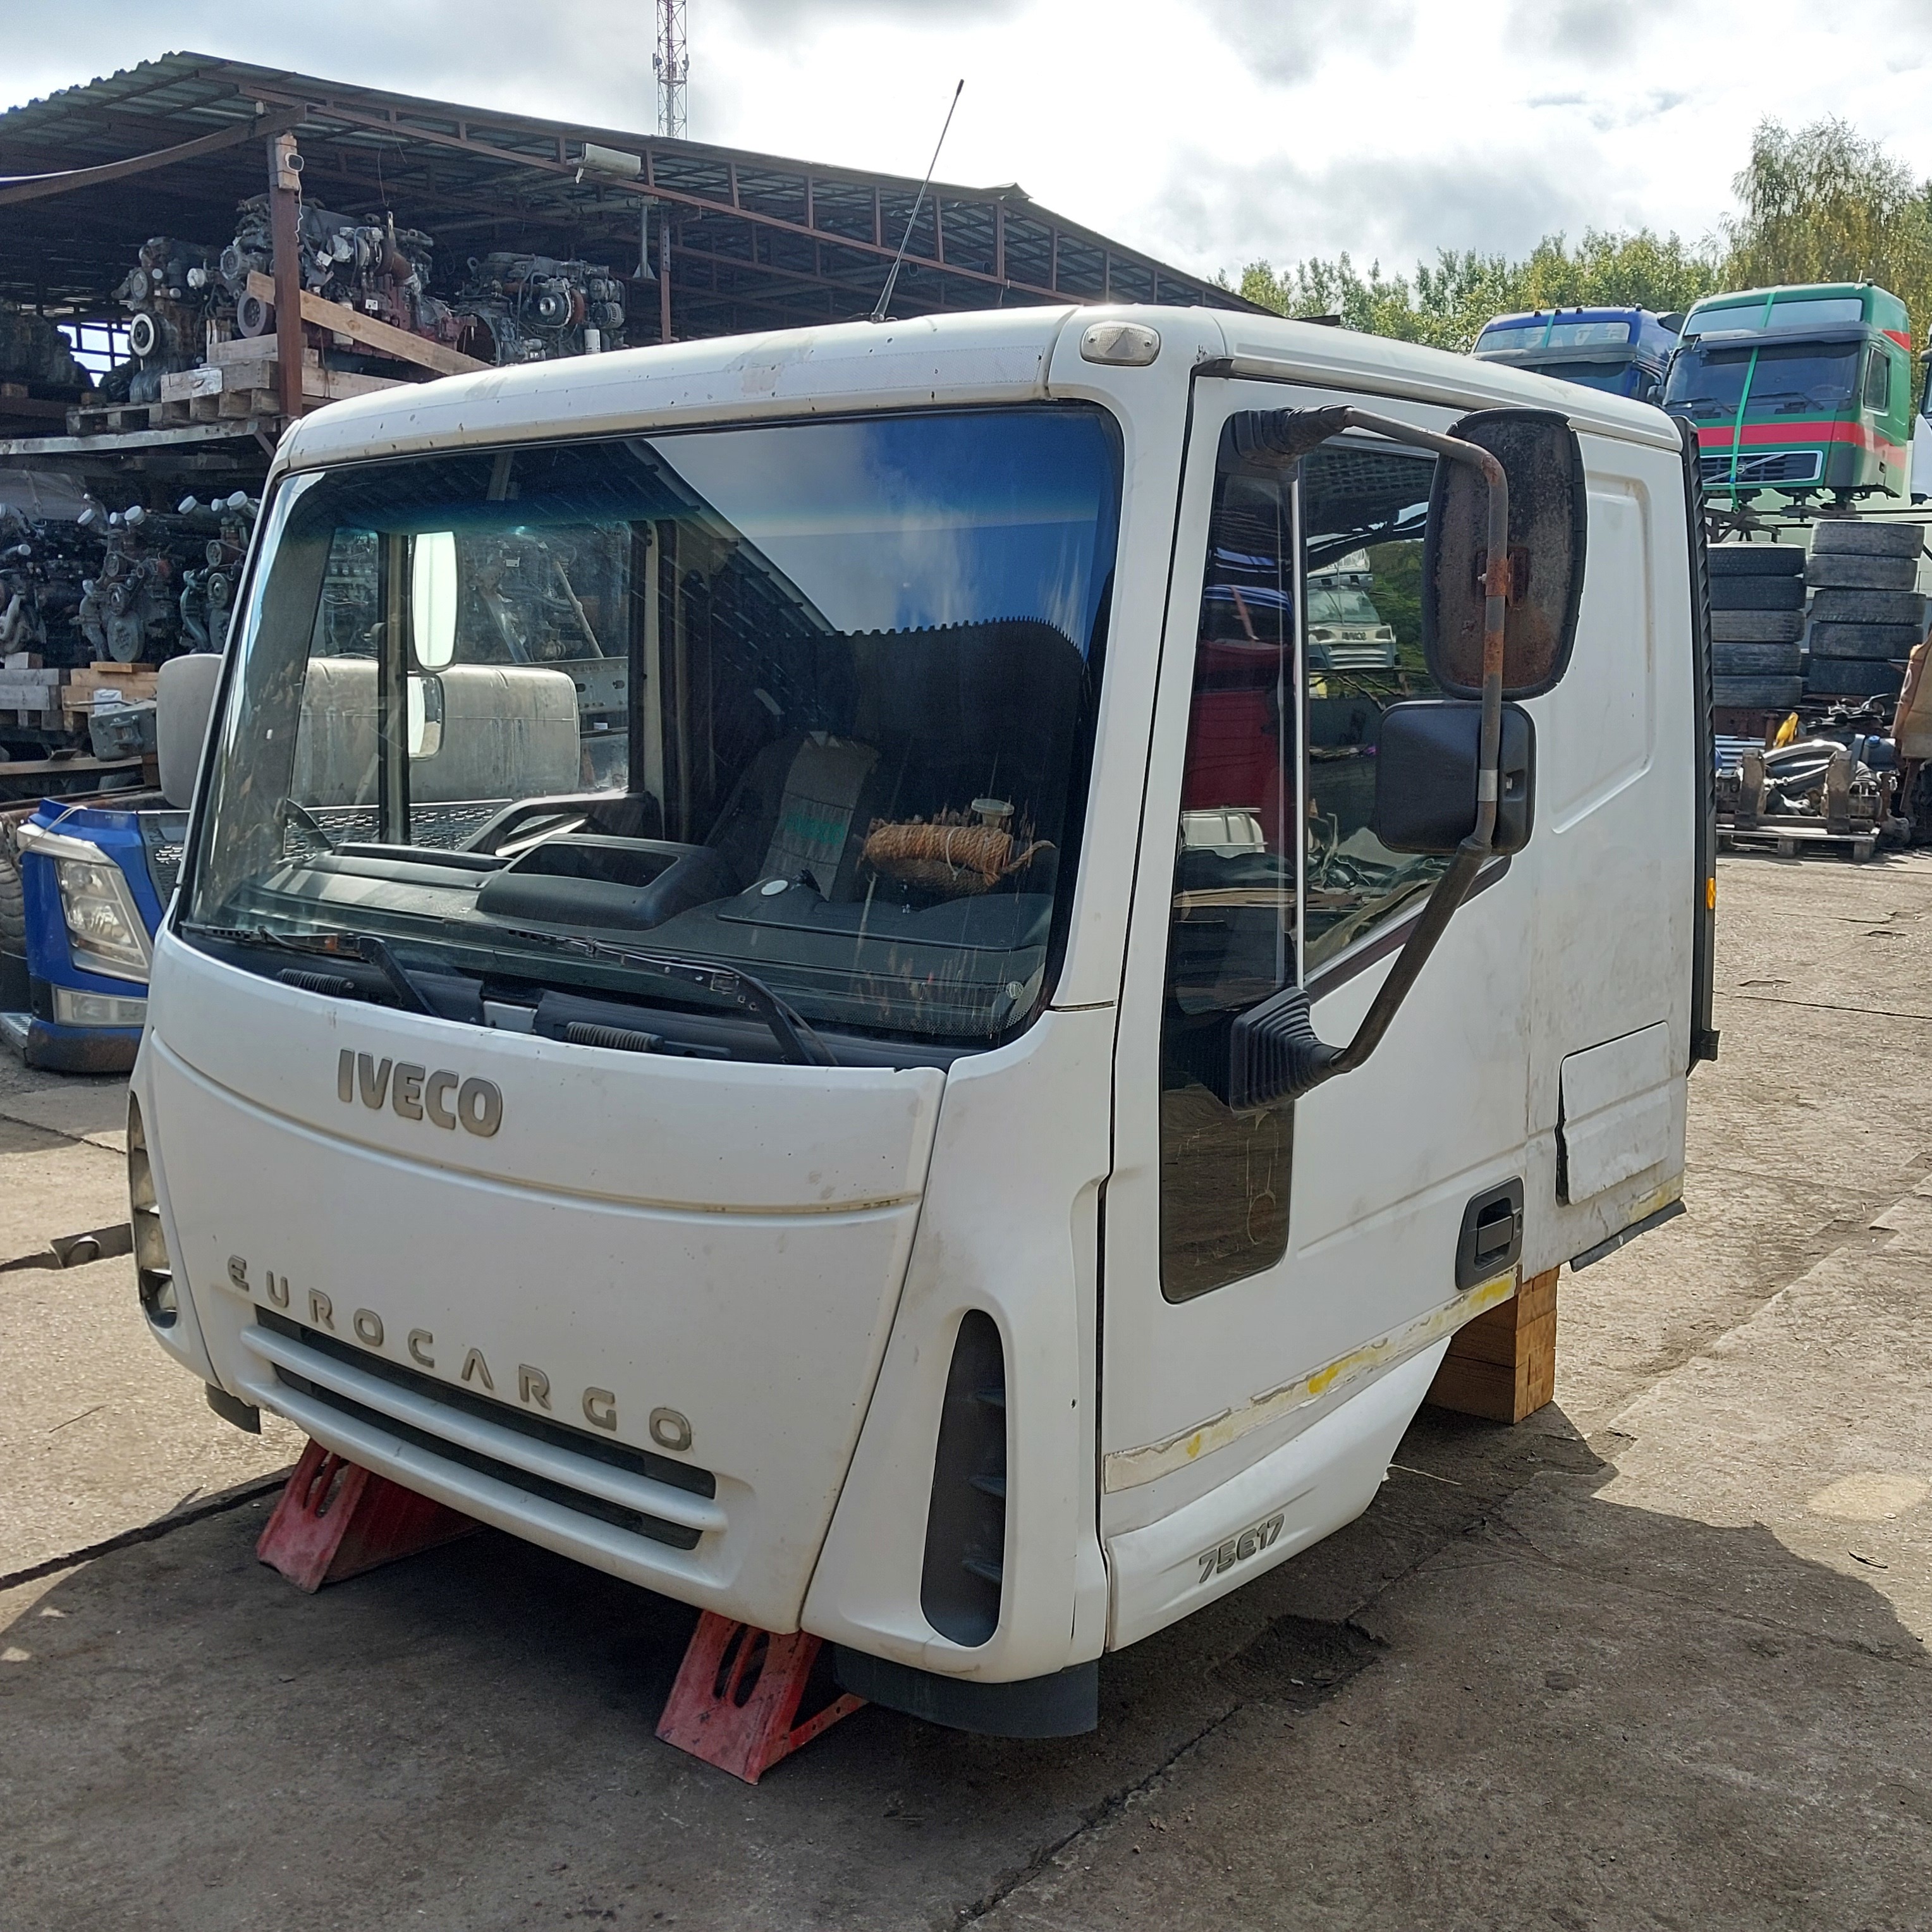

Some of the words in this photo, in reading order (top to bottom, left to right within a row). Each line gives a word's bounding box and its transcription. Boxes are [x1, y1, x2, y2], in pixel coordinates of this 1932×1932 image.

[338, 1049, 503, 1137] IVECO
[228, 1255, 692, 1452] EUROCARGO
[1199, 1513, 1284, 1583] 75E17
